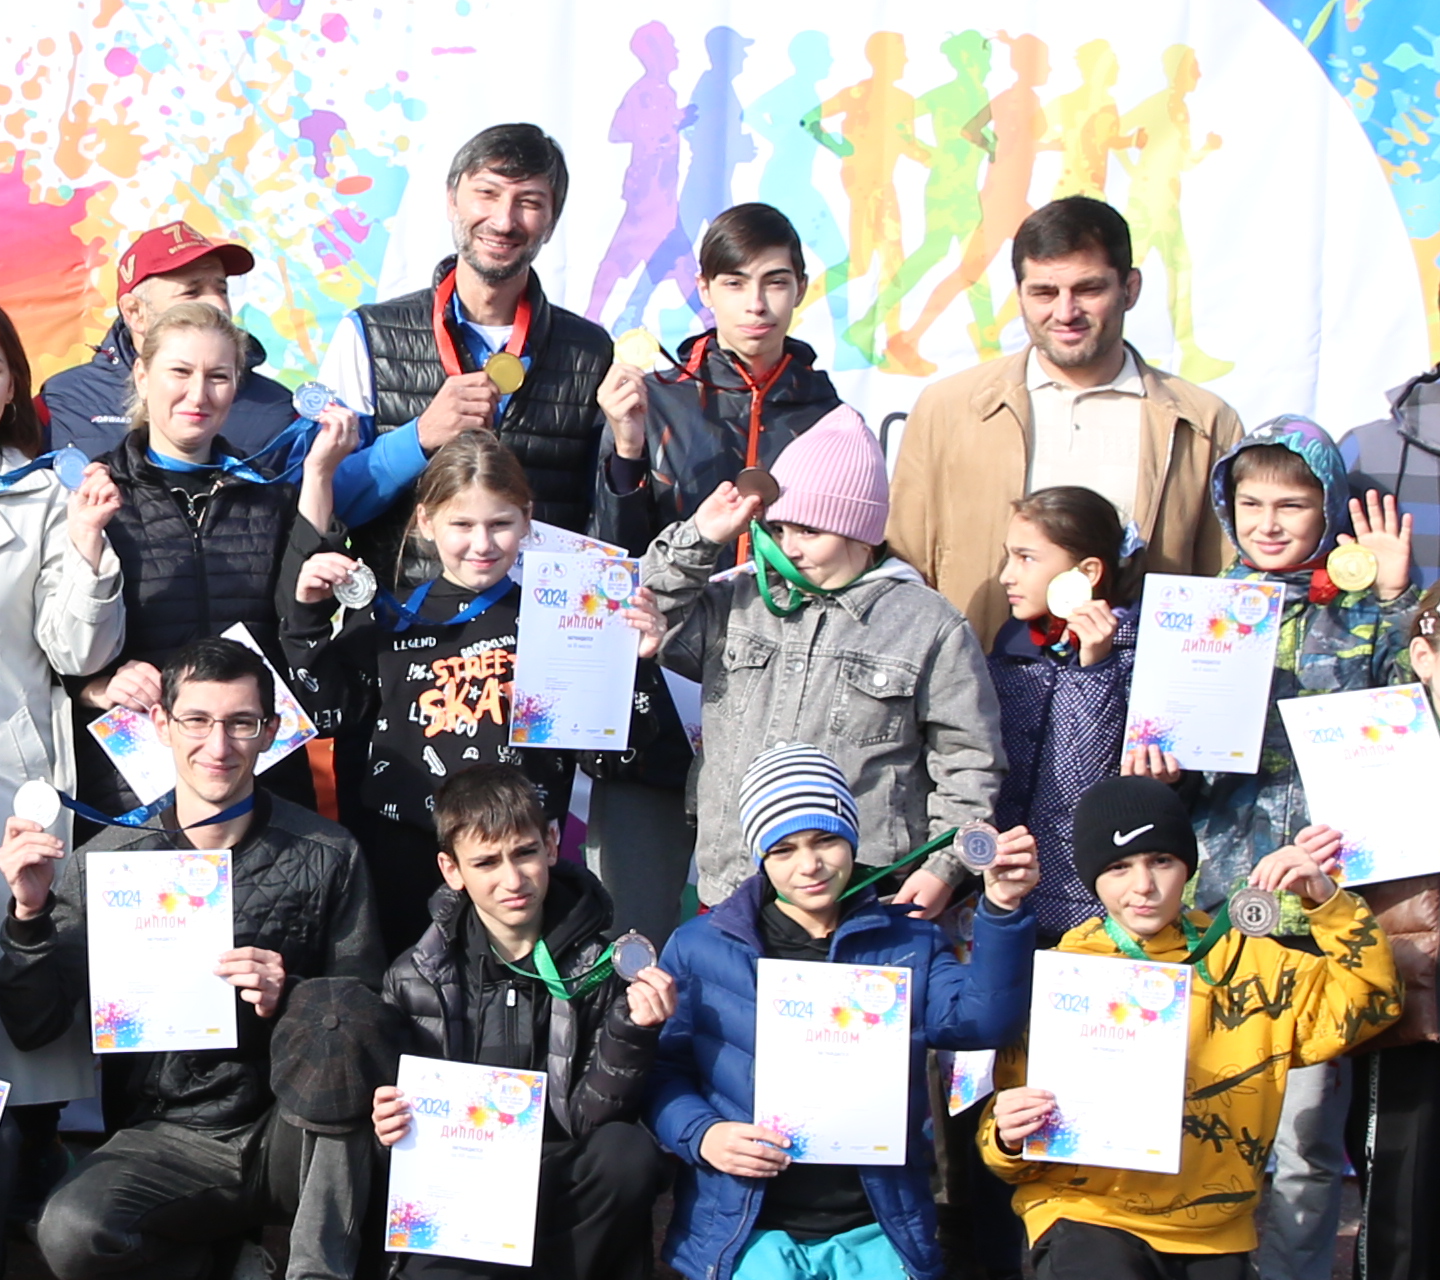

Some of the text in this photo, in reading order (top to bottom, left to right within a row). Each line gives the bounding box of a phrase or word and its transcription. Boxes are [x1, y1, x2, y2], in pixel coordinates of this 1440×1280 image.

[540, 588, 568, 608] 2024
[558, 613, 603, 630] ДИПЛОМ
[1160, 611, 1194, 630] 2024
[393, 636, 437, 651] LEGEND
[1181, 638, 1233, 654] ДИПЛОМ
[1344, 744, 1395, 760] ДИПЛОМ
[108, 890, 142, 907] 2024
[135, 914, 186, 931] ДИПЛОМ
[780, 999, 814, 1019] 2024
[1054, 992, 1090, 1013] 2024
[805, 1028, 860, 1044] ДИПЛОМ
[1080, 1023, 1136, 1040] ДИПЛОМ
[416, 1097, 450, 1117] 2024
[440, 1124, 494, 1141] ДИПЛОМ
